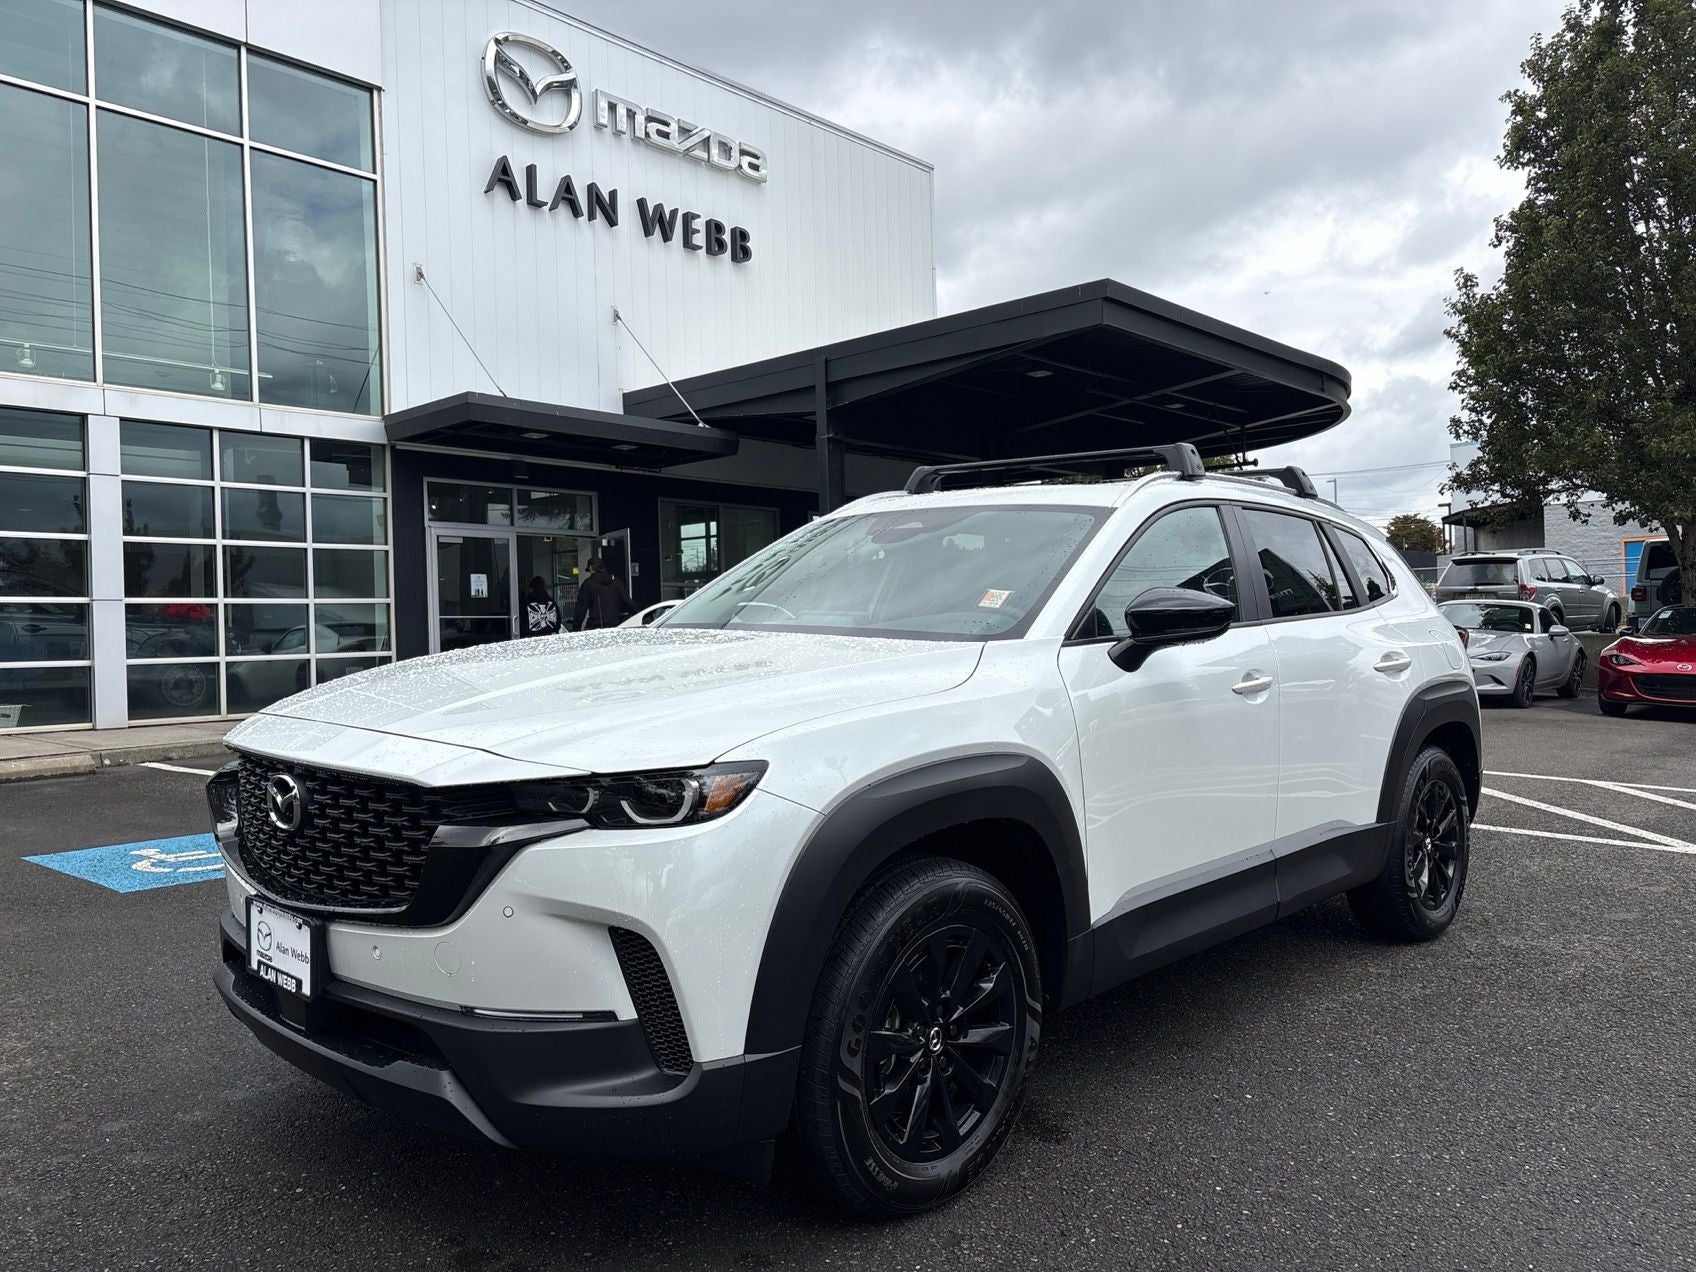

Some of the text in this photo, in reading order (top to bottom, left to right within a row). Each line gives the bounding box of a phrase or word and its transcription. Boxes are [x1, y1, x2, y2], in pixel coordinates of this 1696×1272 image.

[592, 88, 768, 183] mazda
[483, 154, 753, 264] ALAN WEBB
[259, 964, 297, 993] ALAN WEBB
[276, 942, 309, 964] Alan Webb
